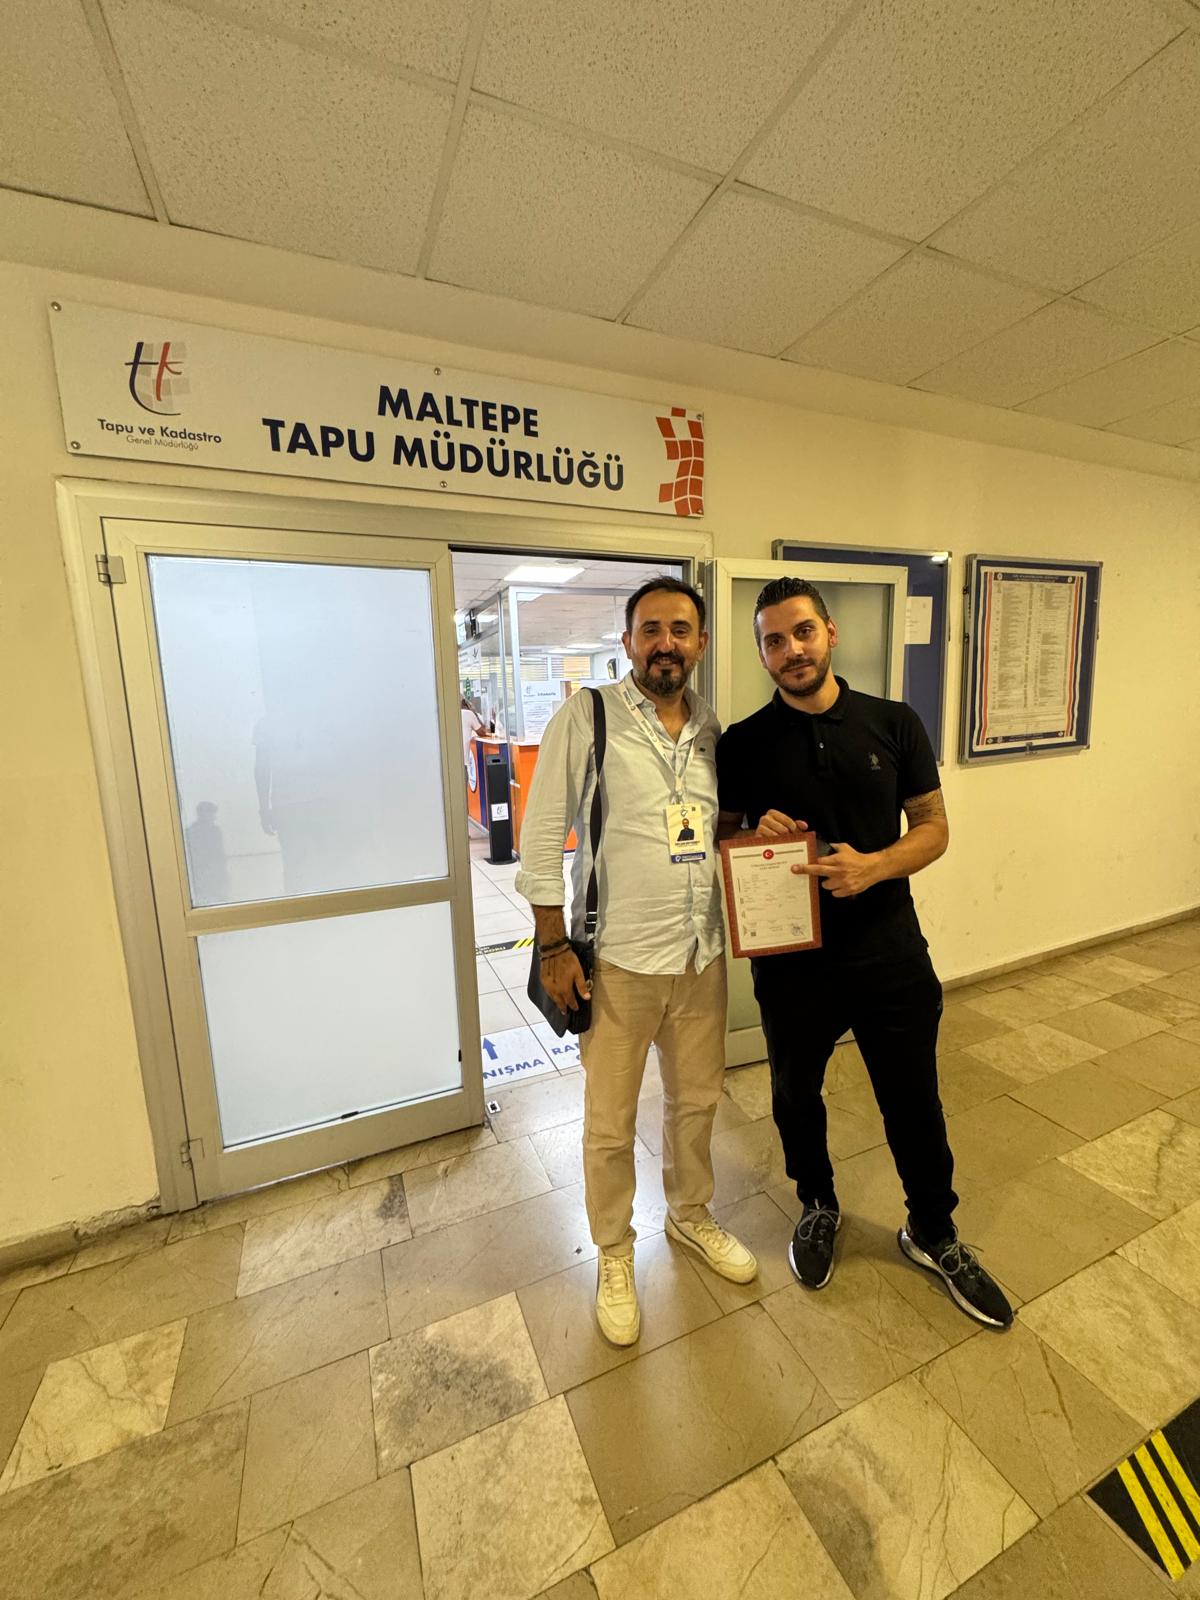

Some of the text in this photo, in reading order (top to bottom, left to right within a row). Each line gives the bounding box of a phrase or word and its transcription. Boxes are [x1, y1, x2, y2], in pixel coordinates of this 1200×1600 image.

[97, 418, 222, 444] Tapu ve Kadastro
[377, 385, 539, 438] MALTEPE
[126, 434, 199, 452] Genel Müdürlüğü
[262, 417, 624, 491] TAPU MÜDÜRLÜĞÜ
